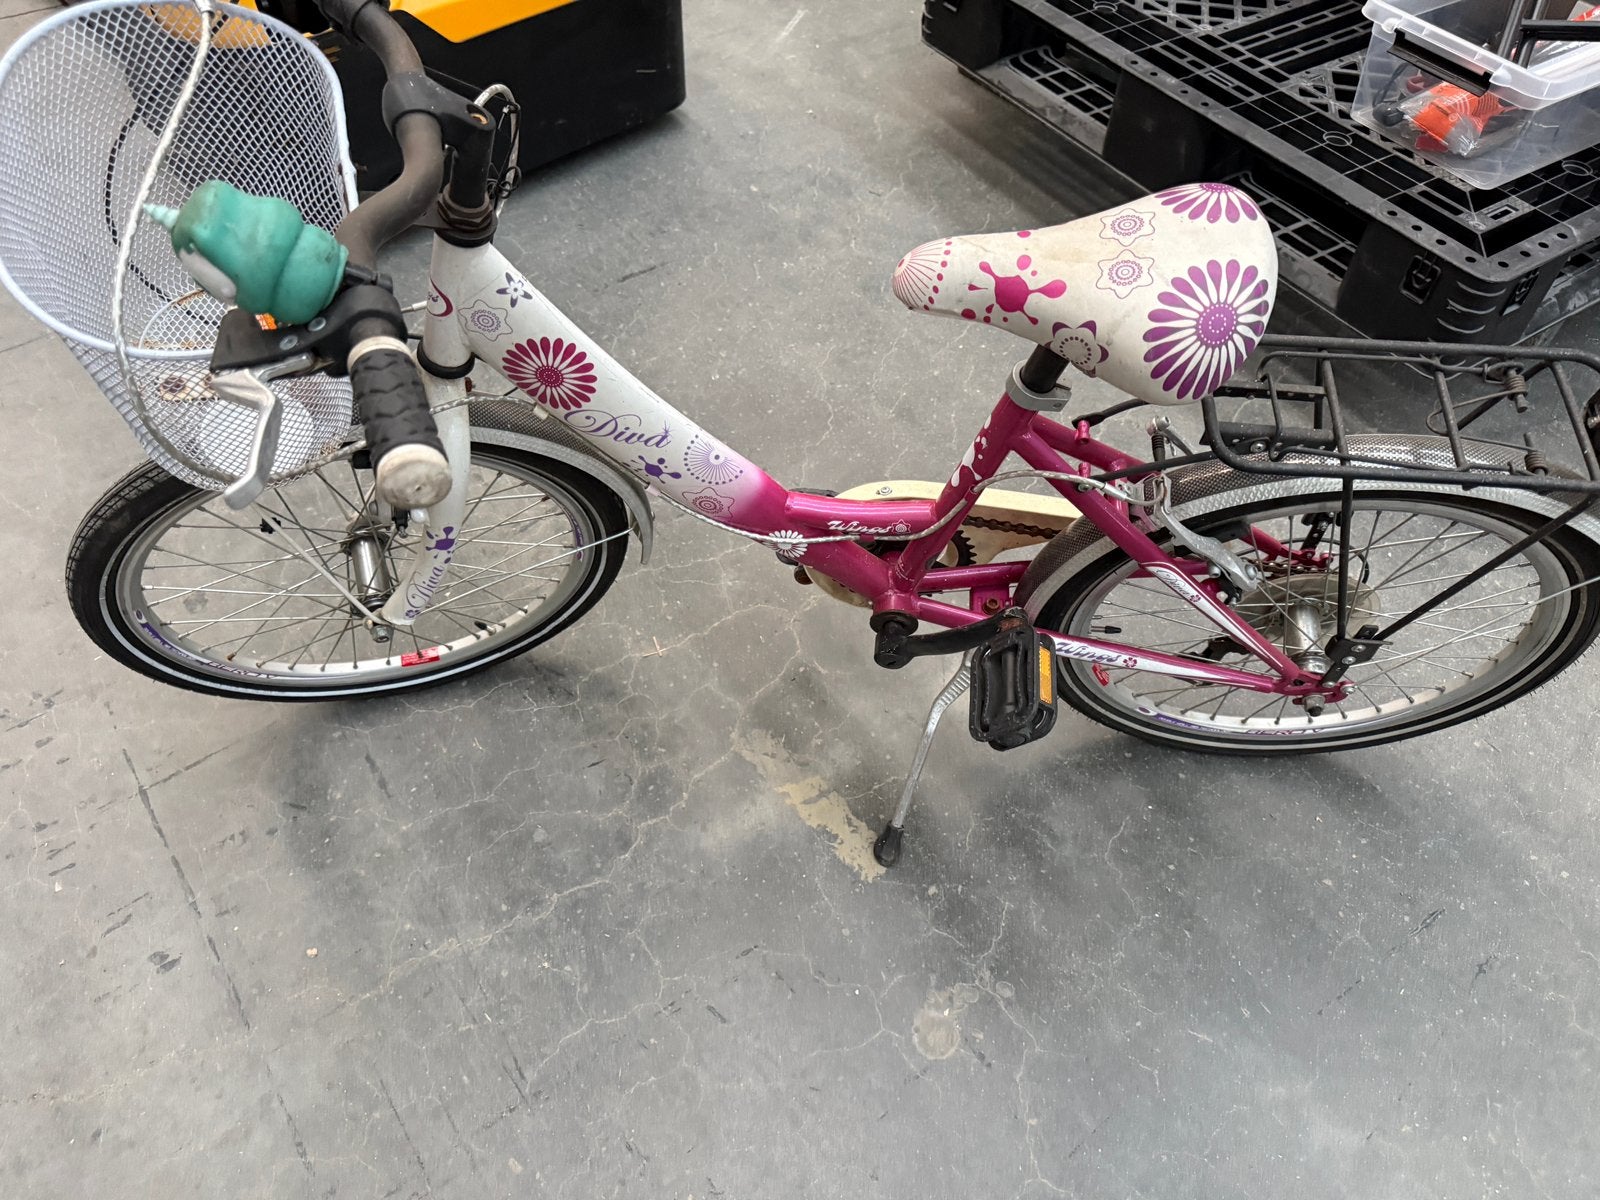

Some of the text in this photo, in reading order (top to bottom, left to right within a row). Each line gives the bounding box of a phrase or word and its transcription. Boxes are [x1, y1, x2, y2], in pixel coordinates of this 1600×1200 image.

[564, 410, 672, 448] Diva
[827, 520, 893, 534] Wings
[406, 565, 444, 609] Diva
[1056, 642, 1122, 663] Wings
